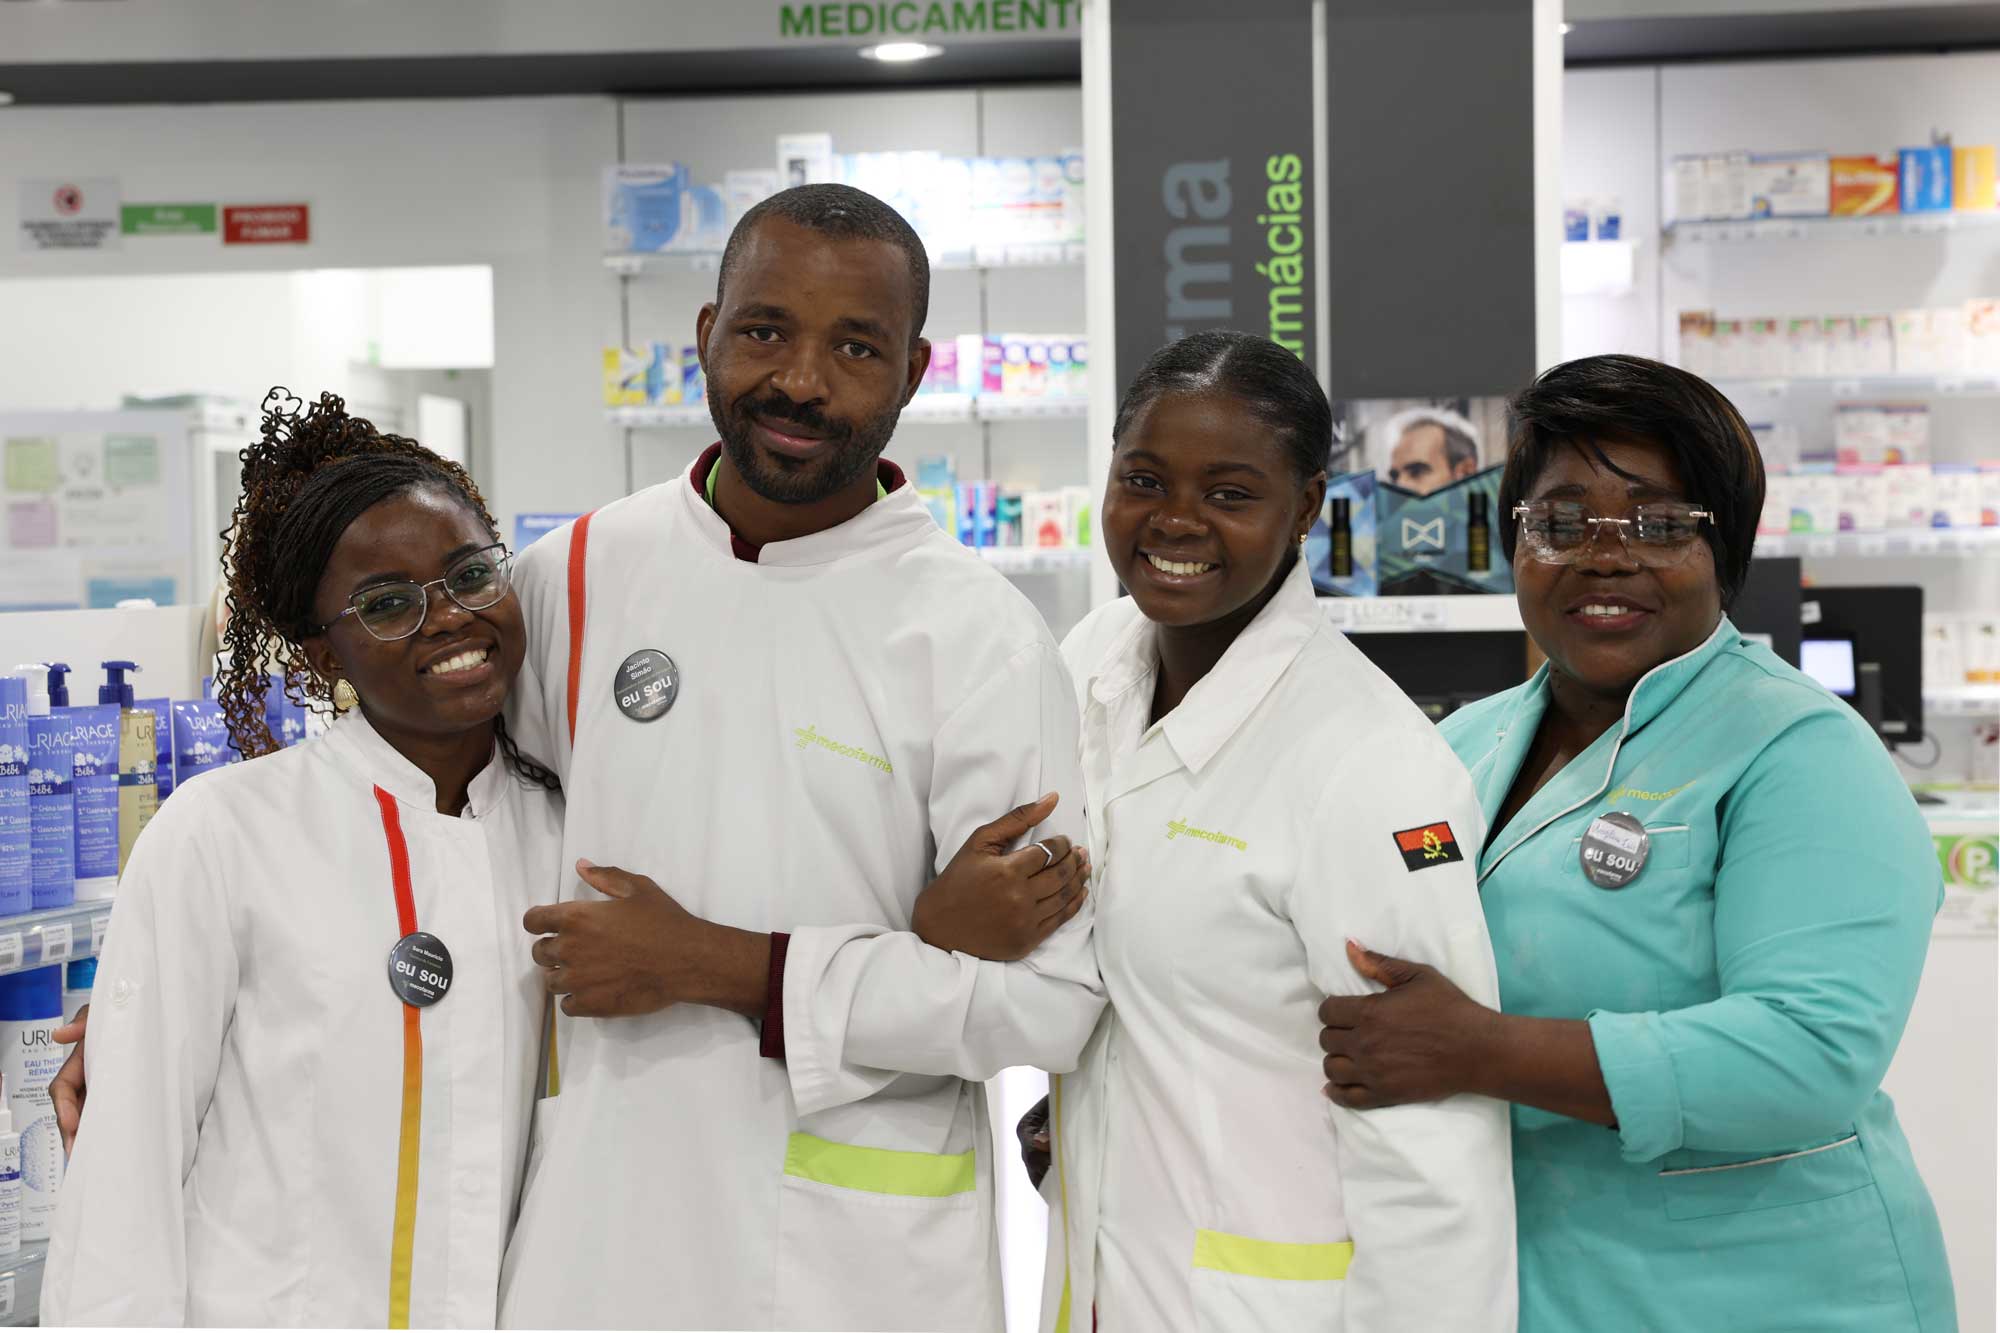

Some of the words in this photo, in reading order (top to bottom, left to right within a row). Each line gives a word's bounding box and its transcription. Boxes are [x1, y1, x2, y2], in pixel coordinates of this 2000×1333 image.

[779, 0, 1083, 37] MEDICAMENT
[1163, 158, 1233, 340] ma
[1255, 153, 1304, 362] rmácias
[625, 657, 650, 673] Jacinto
[621, 690, 641, 708] eu
[643, 675, 673, 697] sou
[1584, 847, 1603, 862] eu
[1606, 854, 1636, 873] sou
[395, 960, 416, 977] eu
[419, 969, 448, 990] sou
